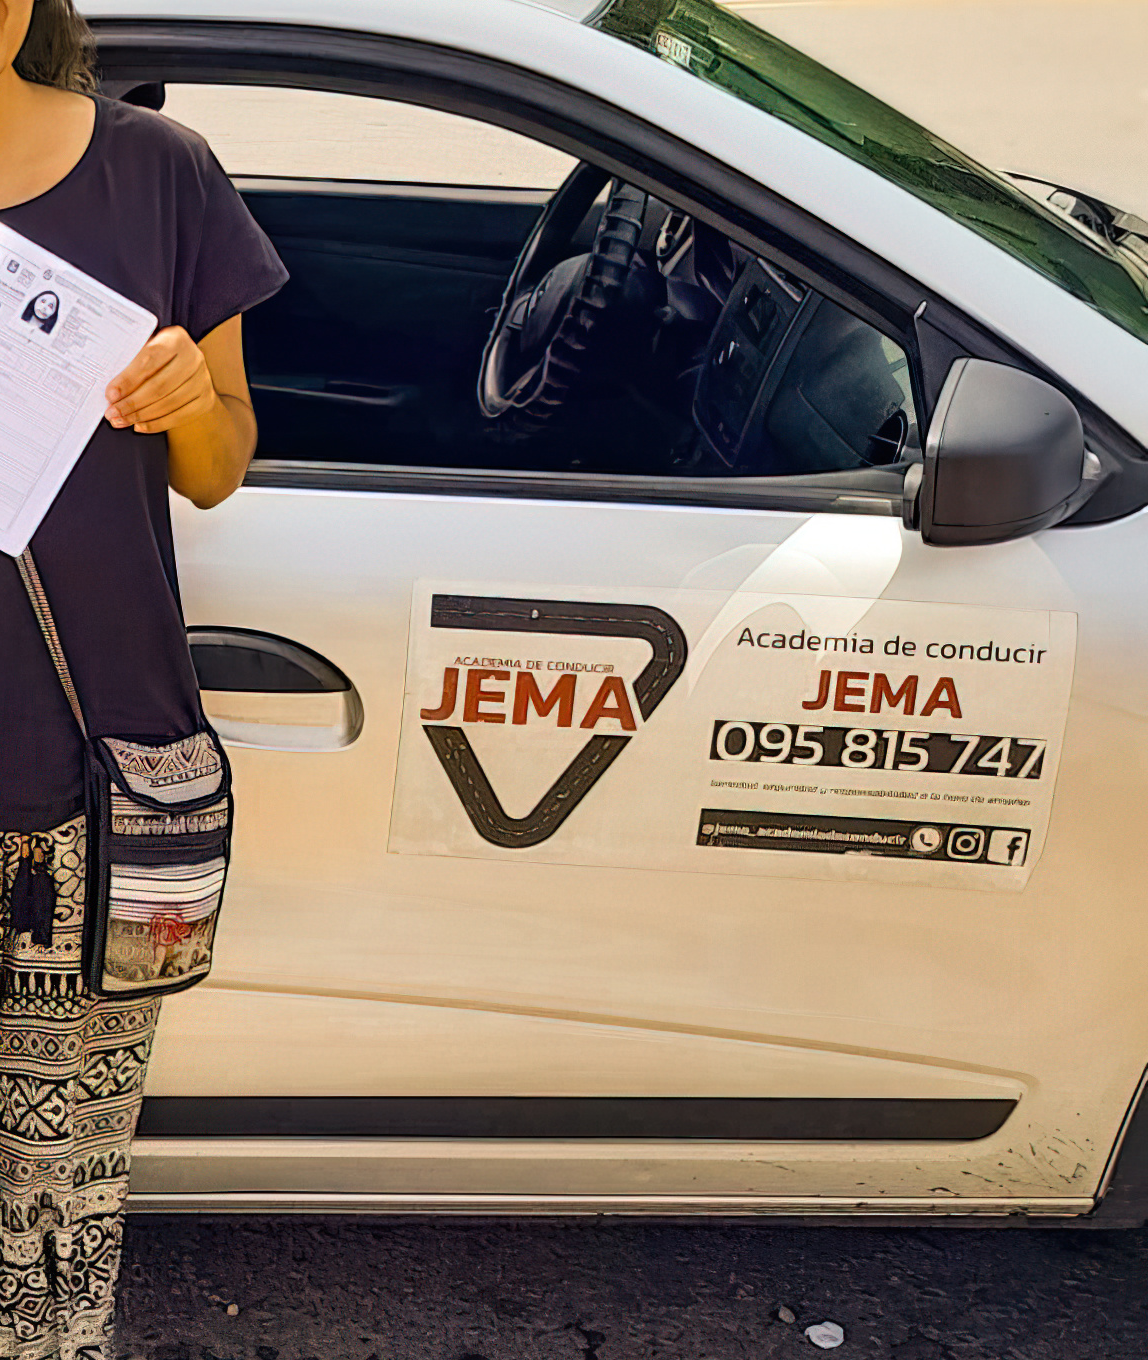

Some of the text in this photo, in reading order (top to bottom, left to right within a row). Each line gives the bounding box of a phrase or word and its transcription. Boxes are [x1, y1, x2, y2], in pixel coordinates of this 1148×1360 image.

[454, 656, 521, 668] ACADEMIA
[526, 660, 543, 670] DE
[737, 627, 1047, 664] Academia de conducir
[420, 667, 637, 731] JEMA
[801, 669, 963, 719] JEMA
[716, 721, 1047, 778] 095 815 747
